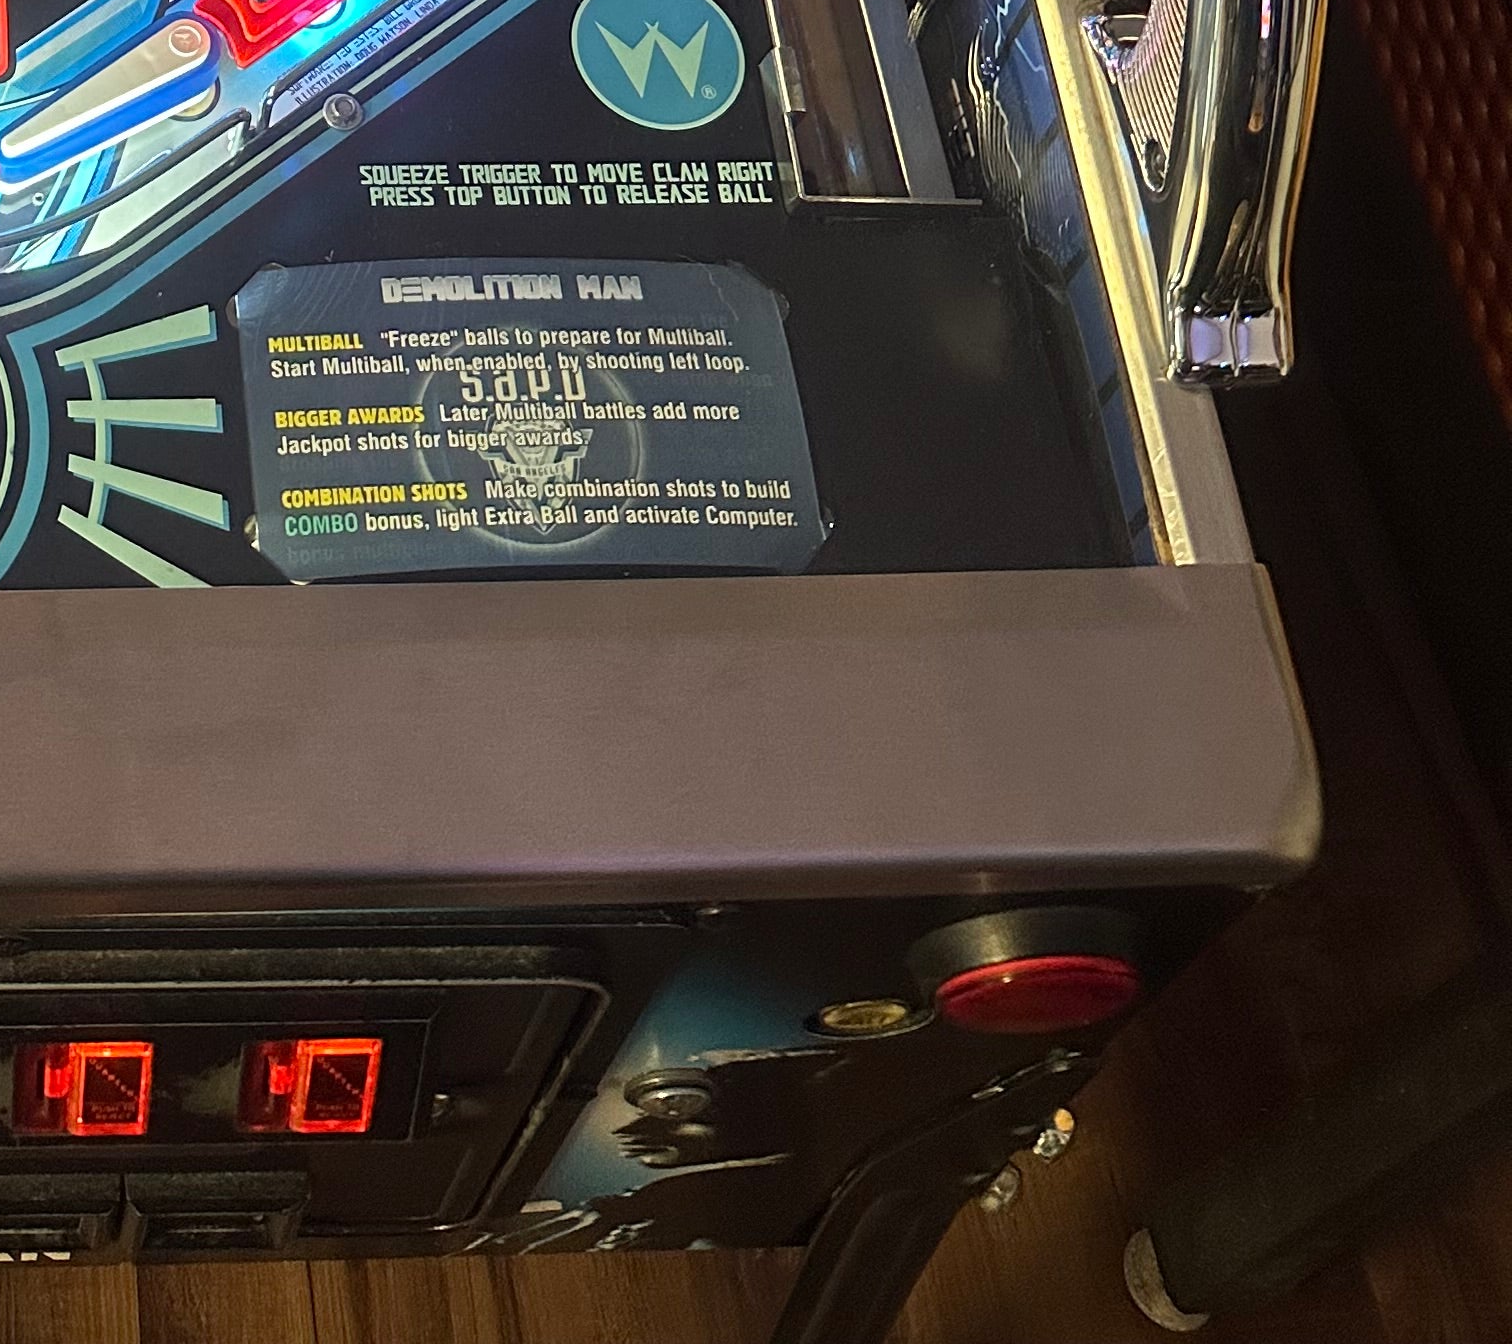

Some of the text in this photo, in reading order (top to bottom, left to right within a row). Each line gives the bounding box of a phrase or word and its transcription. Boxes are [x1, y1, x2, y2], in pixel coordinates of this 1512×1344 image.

[359, 161, 774, 185] SQUEEZE TRIGGER TO MOVE CLAW RIGHT
[369, 182, 773, 207] PRESS TOP BUTTON TO RELEASE BALL
[380, 274, 644, 304] DEMOLITION MAN
[267, 327, 733, 353] MULTIBALL "Freeze" balls to prepare for Multiball.
[270, 351, 750, 379] Start Multiball, when enabled, by shooting left loop.
[274, 402, 740, 429] BIGGER AWARDS Later Multiball battles add more
[277, 427, 588, 456] Jackpot shots for bigger awards.
[281, 479, 792, 510] COMBINATION SHOTS Make combination shots to build
[284, 505, 799, 537] COMBO bonus, light Extra Ball and activate Computer.
